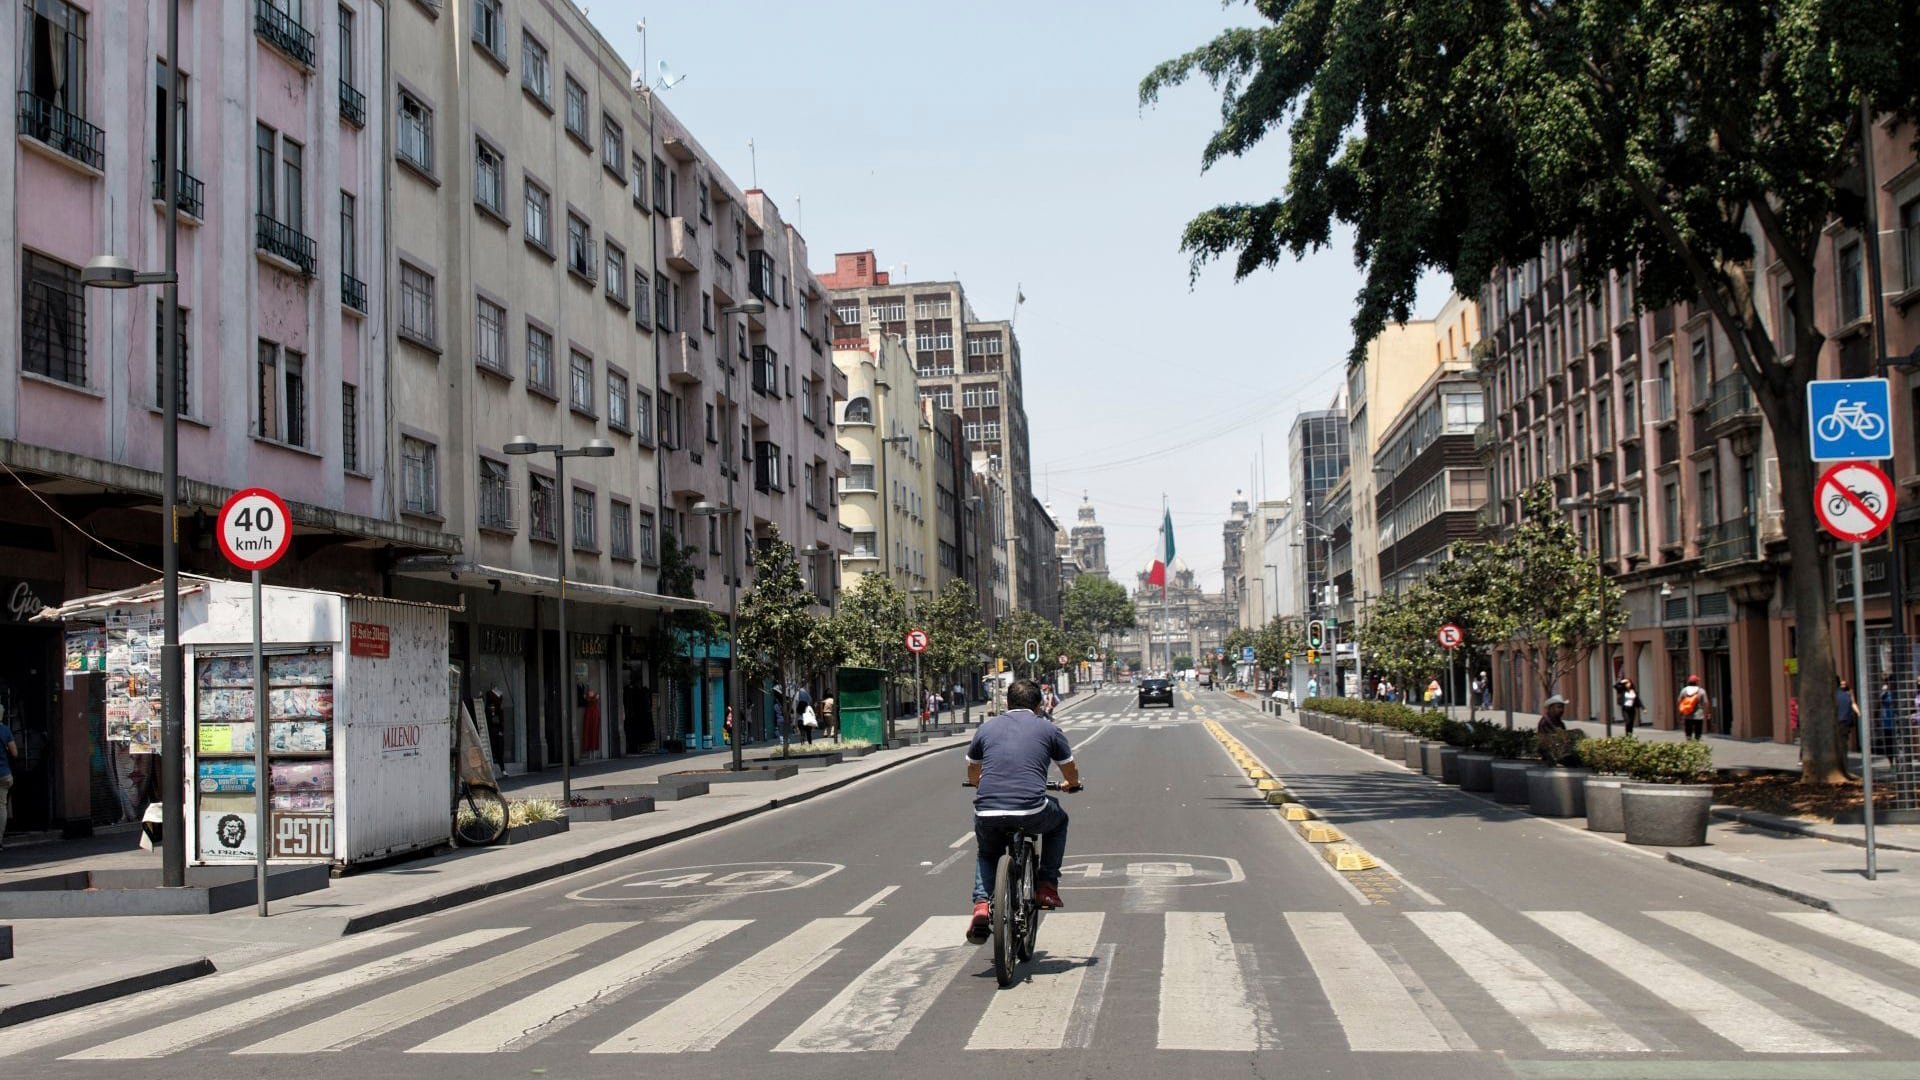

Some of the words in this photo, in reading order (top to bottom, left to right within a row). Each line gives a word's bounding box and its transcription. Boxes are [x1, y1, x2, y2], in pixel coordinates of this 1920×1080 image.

[234, 507, 274, 532] 40
[235, 536, 272, 551] km/h
[383, 725, 420, 749] MILENIO
[218, 849, 257, 857] PRENS
[1059, 862, 1194, 878] 40
[622, 870, 793, 888] 40
